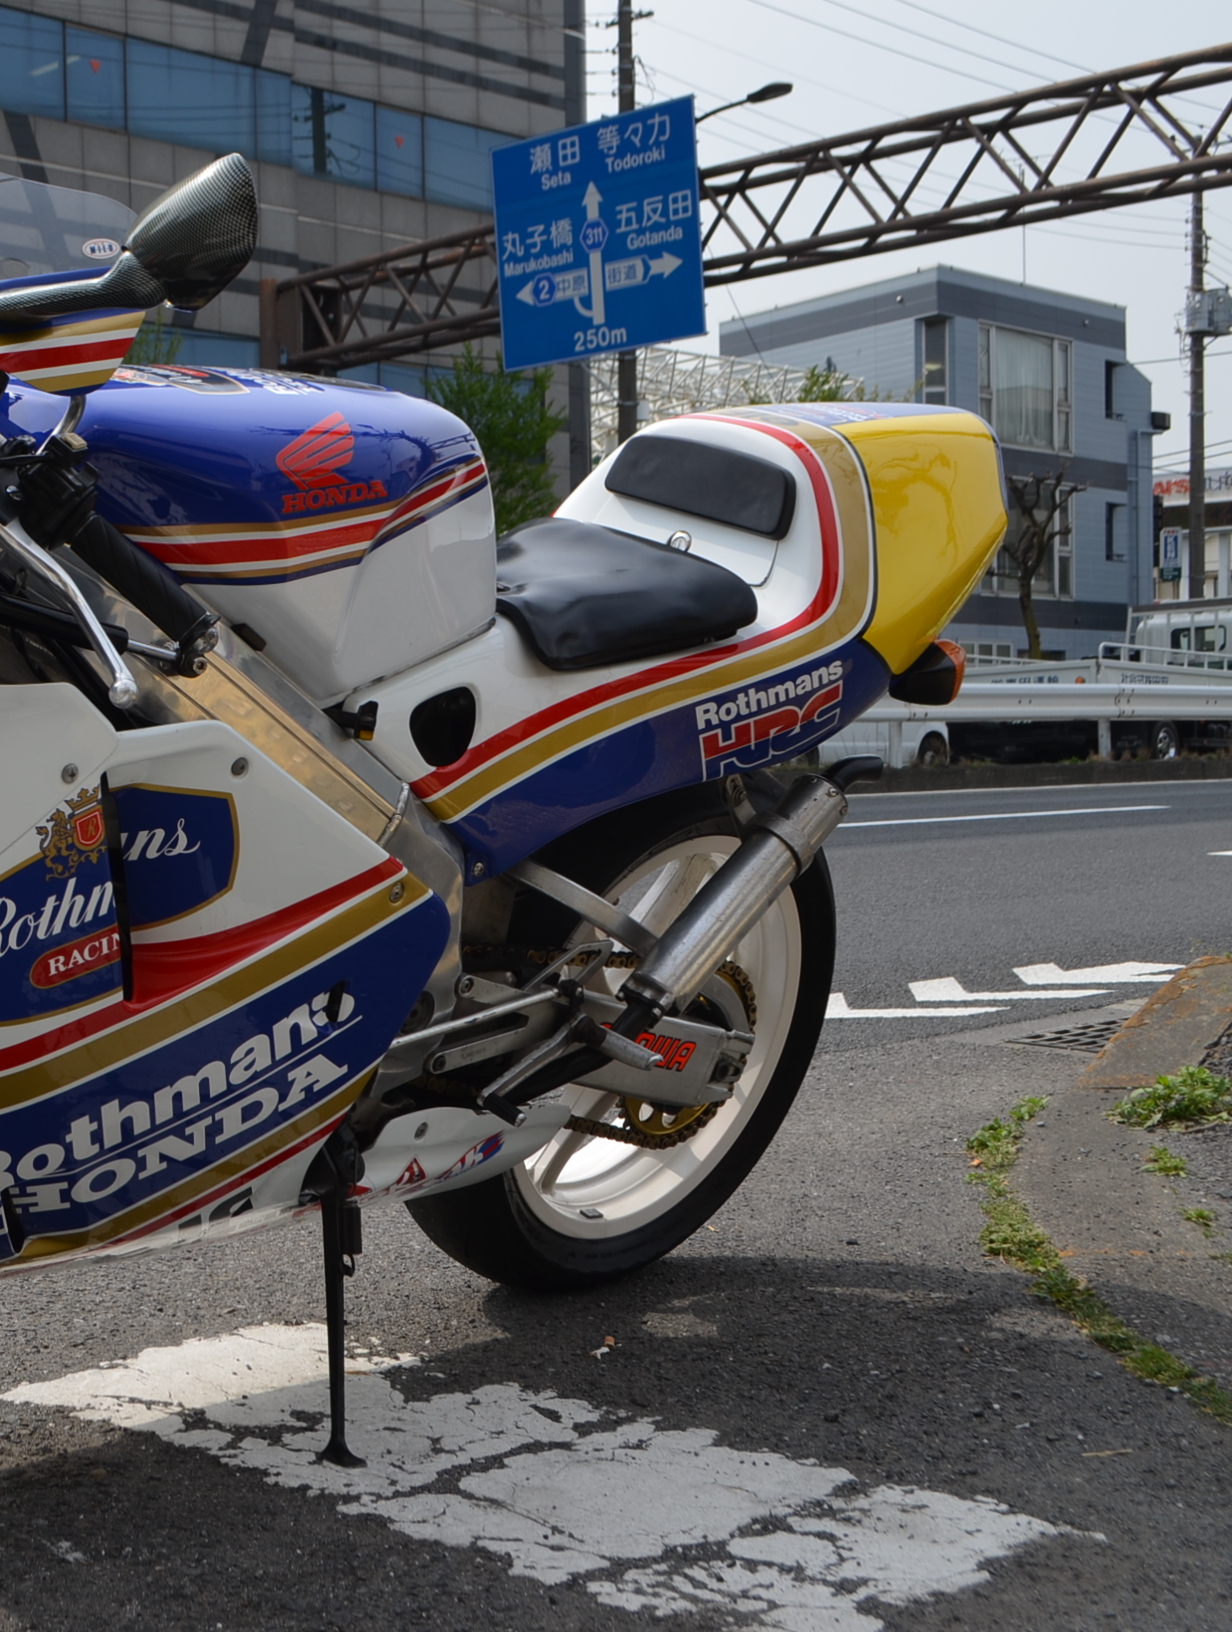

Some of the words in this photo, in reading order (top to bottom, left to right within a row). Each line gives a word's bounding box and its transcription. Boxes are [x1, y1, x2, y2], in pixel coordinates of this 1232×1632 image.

[529, 135, 580, 175] 瀬田
[596, 112, 670, 156] 等々力
[605, 145, 666, 174] Todoroki
[541, 170, 572, 191] Seta
[615, 189, 693, 234] 五反田
[502, 217, 573, 261] 丸子橋
[585, 226, 604, 246] 311
[627, 225, 683, 250] Gotanda
[503, 250, 574, 278] Marukobashi
[607, 262, 638, 285] 街道
[538, 279, 551, 301] 2
[556, 273, 586, 295] 中原
[573, 326, 628, 352] 250m
[281, 480, 388, 515] HONDA
[695, 660, 843, 731] Rothmans
[699, 680, 843, 783] HRC
[47, 931, 123, 977] RACIN
